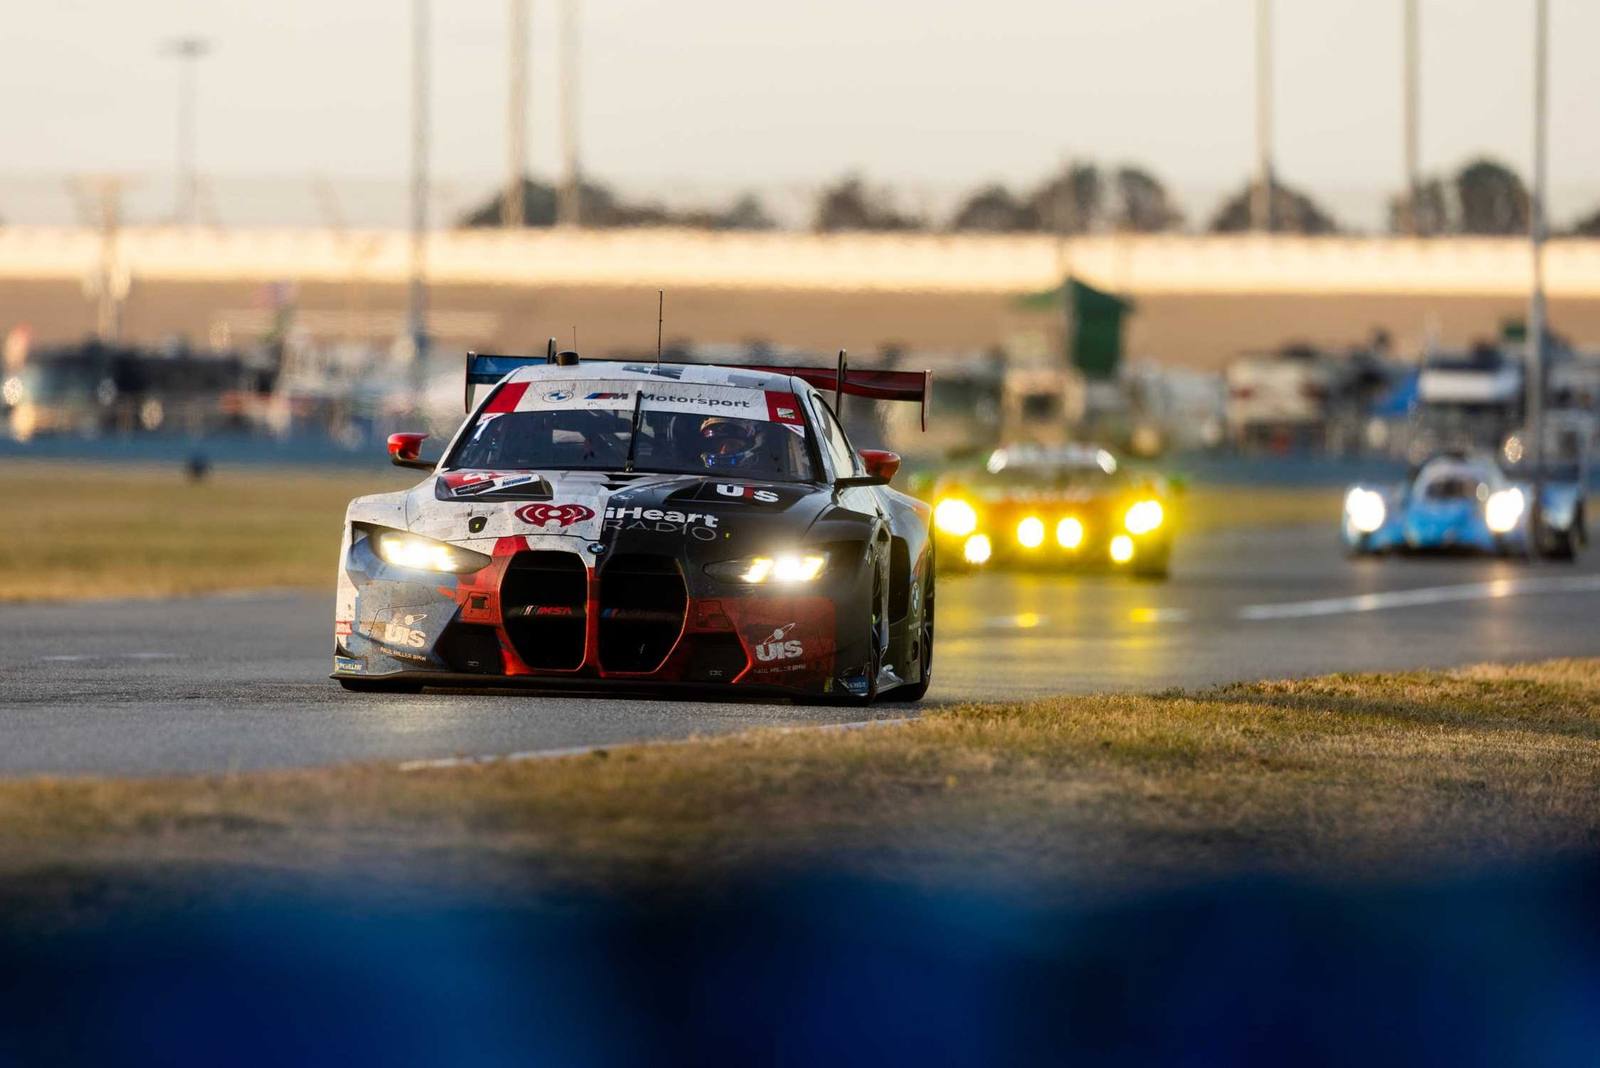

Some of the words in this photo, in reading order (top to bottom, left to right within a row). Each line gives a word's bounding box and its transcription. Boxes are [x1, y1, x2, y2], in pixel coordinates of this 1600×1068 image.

[639, 393, 750, 408] Motorsport
[604, 507, 719, 528] iHeart
[602, 519, 717, 541] RADIO
